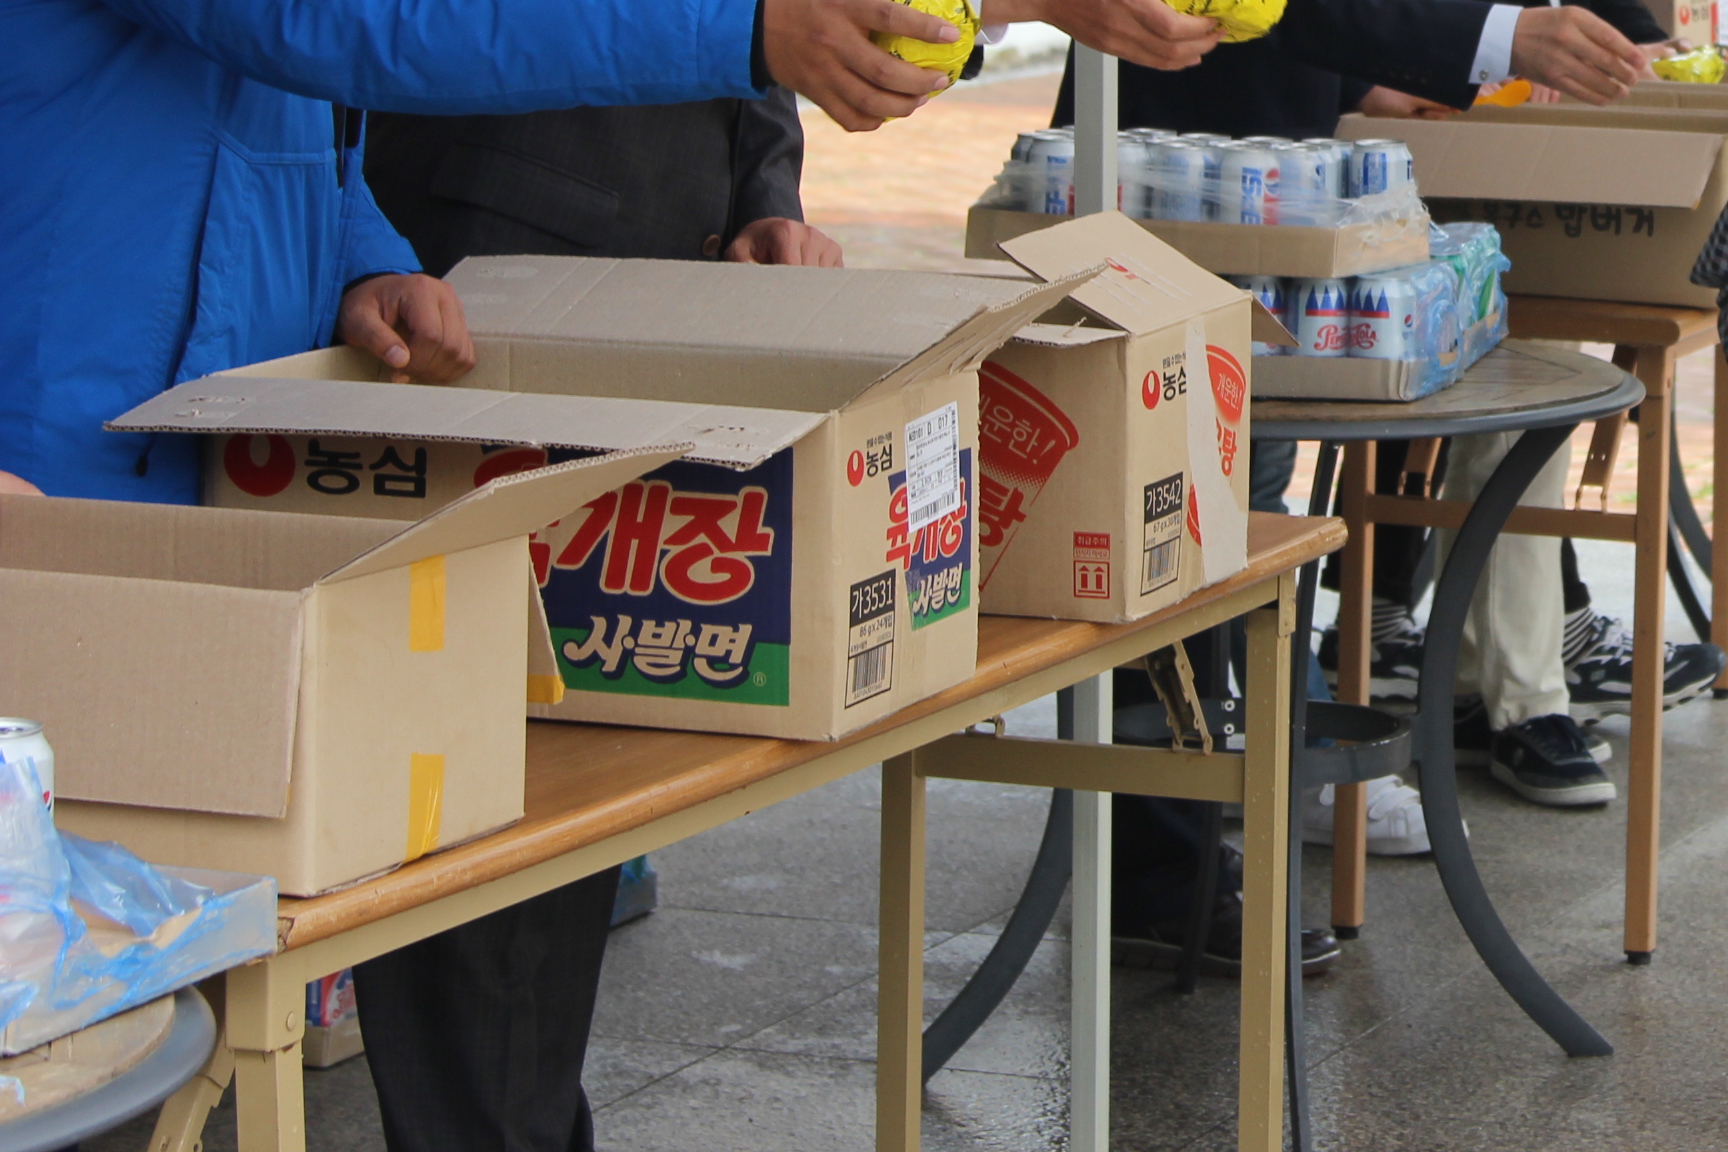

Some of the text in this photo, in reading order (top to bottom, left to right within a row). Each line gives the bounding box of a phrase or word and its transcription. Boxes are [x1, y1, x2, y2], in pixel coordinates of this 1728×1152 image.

[866, 443, 892, 477] 농심
[979, 394, 1056, 465] 운한!
[304, 438, 427, 499] 농심
[1146, 479, 1181, 516] 가3542
[500, 463, 775, 605] 개장
[852, 577, 893, 619] 가3531
[563, 614, 753, 682] 사발면
